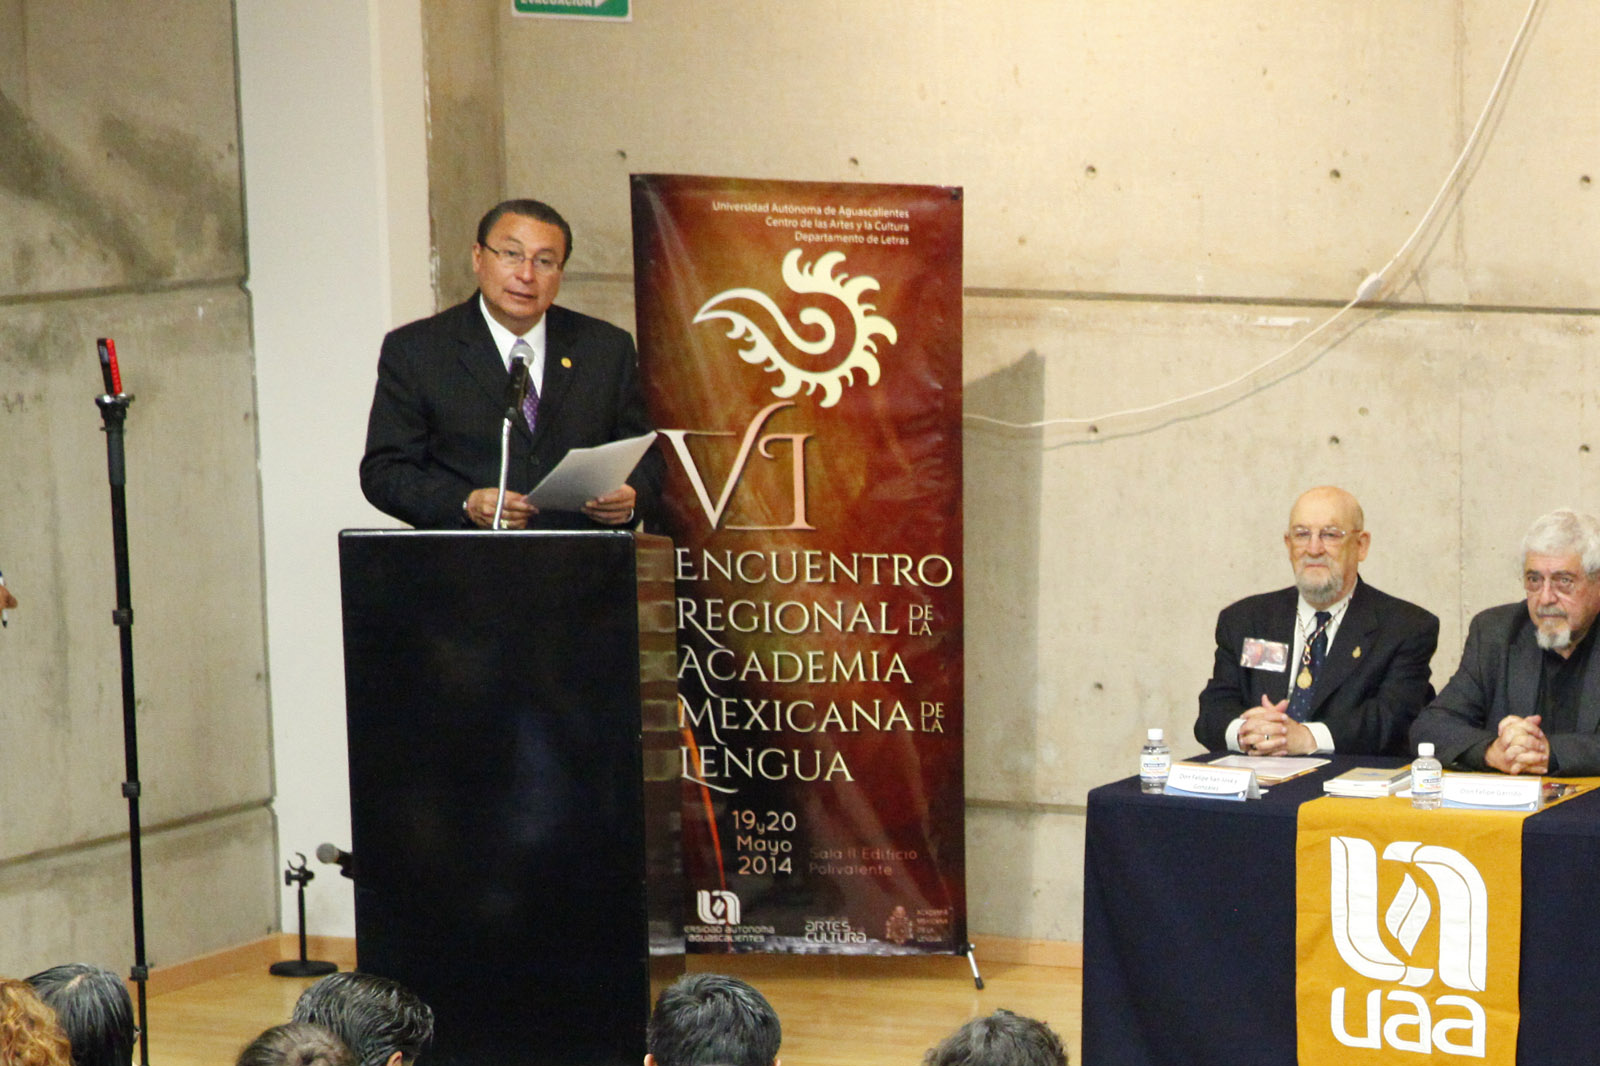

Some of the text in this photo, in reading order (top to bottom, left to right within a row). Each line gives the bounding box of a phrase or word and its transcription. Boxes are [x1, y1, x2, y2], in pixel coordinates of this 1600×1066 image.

[712, 201, 909, 219] Universidad Autónoma de Aguascalientes
[765, 216, 909, 232] Centro de las Artes y la Cultura
[795, 231, 909, 245] Departamento de Letras
[657, 401, 816, 530] VI
[675, 548, 953, 587] ENCUENTRO
[677, 597, 934, 648] REGIONAL DE
[908, 621, 933, 636] LA
[677, 645, 913, 698] ACADEMIA
[677, 693, 945, 745] MEXICANA DE
[921, 718, 944, 733] LA
[680, 746, 855, 793] LENGUA
[736, 835, 792, 856] Mayo
[809, 847, 842, 860] Sala
[862, 848, 918, 861] Edificio
[738, 856, 793, 875] 2014
[809, 863, 893, 876] Polivalente
